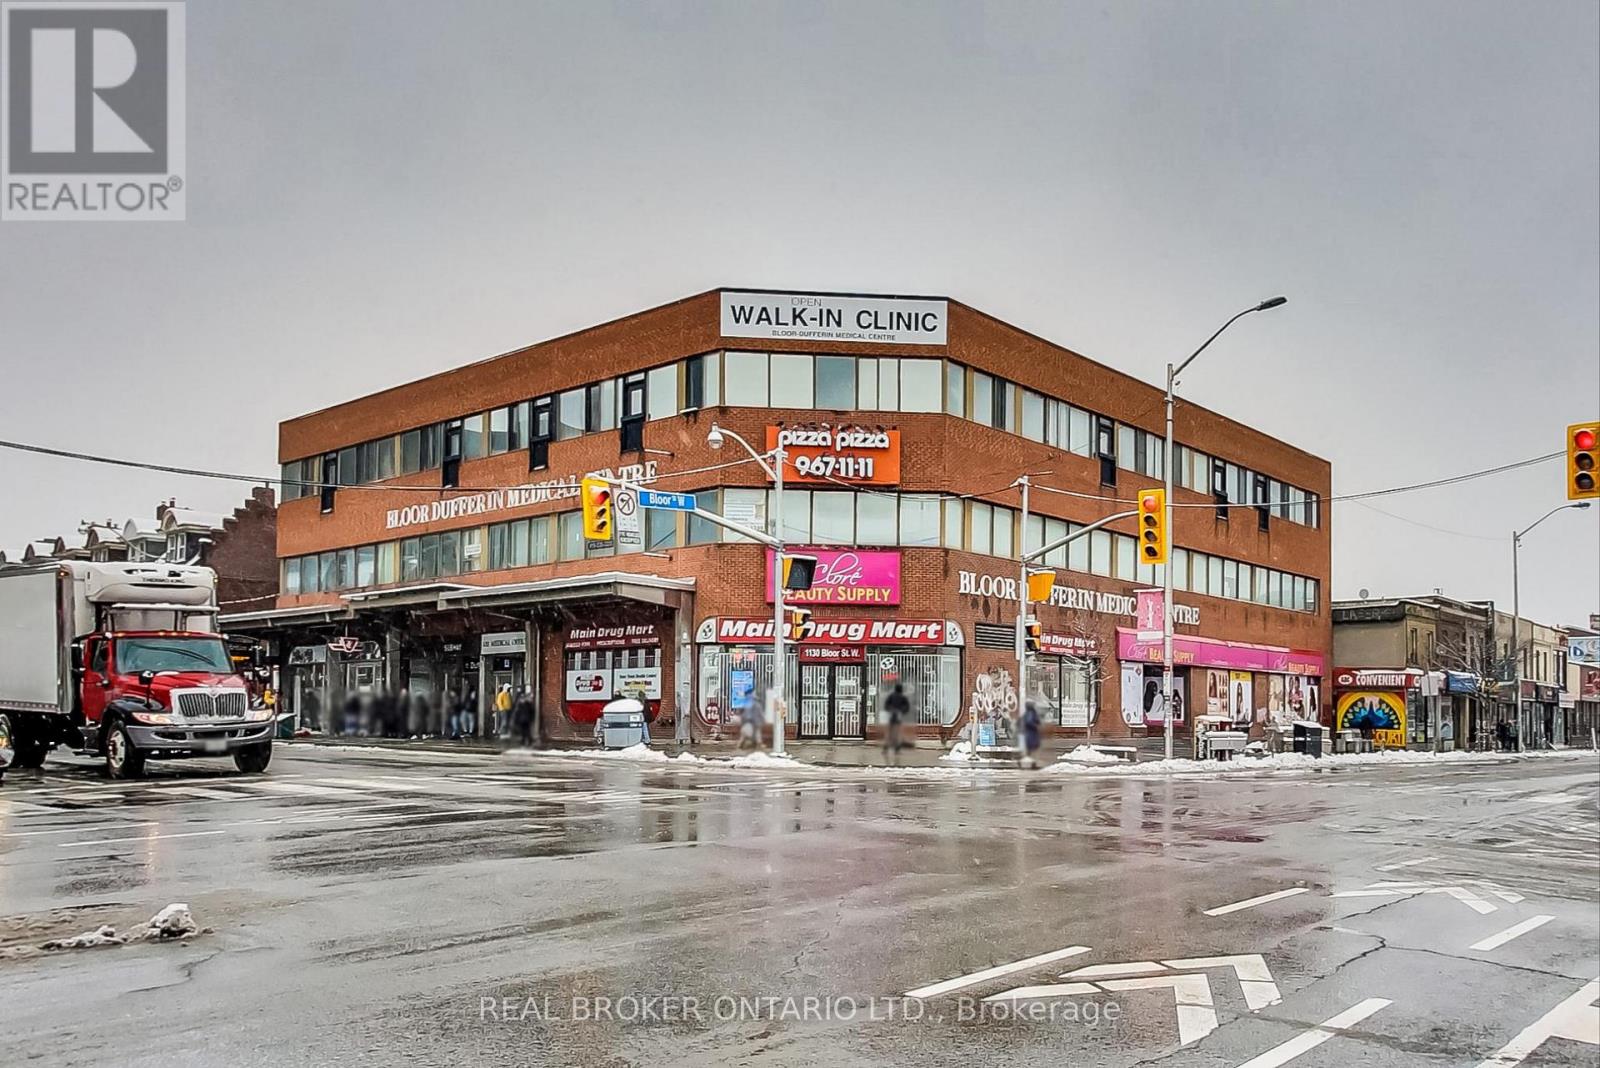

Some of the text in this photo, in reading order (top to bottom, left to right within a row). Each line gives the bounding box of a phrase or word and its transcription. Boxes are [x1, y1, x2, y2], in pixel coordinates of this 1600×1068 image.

[791, 297, 822, 307] OPEN
[731, 305, 938, 333] WALK-IN CLINIC
[835, 331, 866, 340] MEDICAL
[868, 333, 896, 341] CENTRE
[778, 430, 890, 451] pizza pizza
[386, 505, 429, 528] BLOOR
[507, 475, 581, 508] MEDICAL
[650, 493, 671, 505] Bloor
[678, 496, 685, 507] W
[782, 585, 891, 602] EAUTY SUPPLY
[959, 571, 1017, 601] BLOOR
[1096, 591, 1138, 617] MEDIC
[570, 624, 655, 639] Main Drug Mart
[720, 619, 792, 638] Main
[870, 621, 942, 639] Mart
[1052, 635, 1074, 648] Drug
[804, 649, 820, 657] 1130
[821, 649, 840, 657] Bloor
[851, 650, 861, 658] W.
[1173, 650, 1194, 663] SUPPLY
[1356, 674, 1407, 687] CONVENIENT
